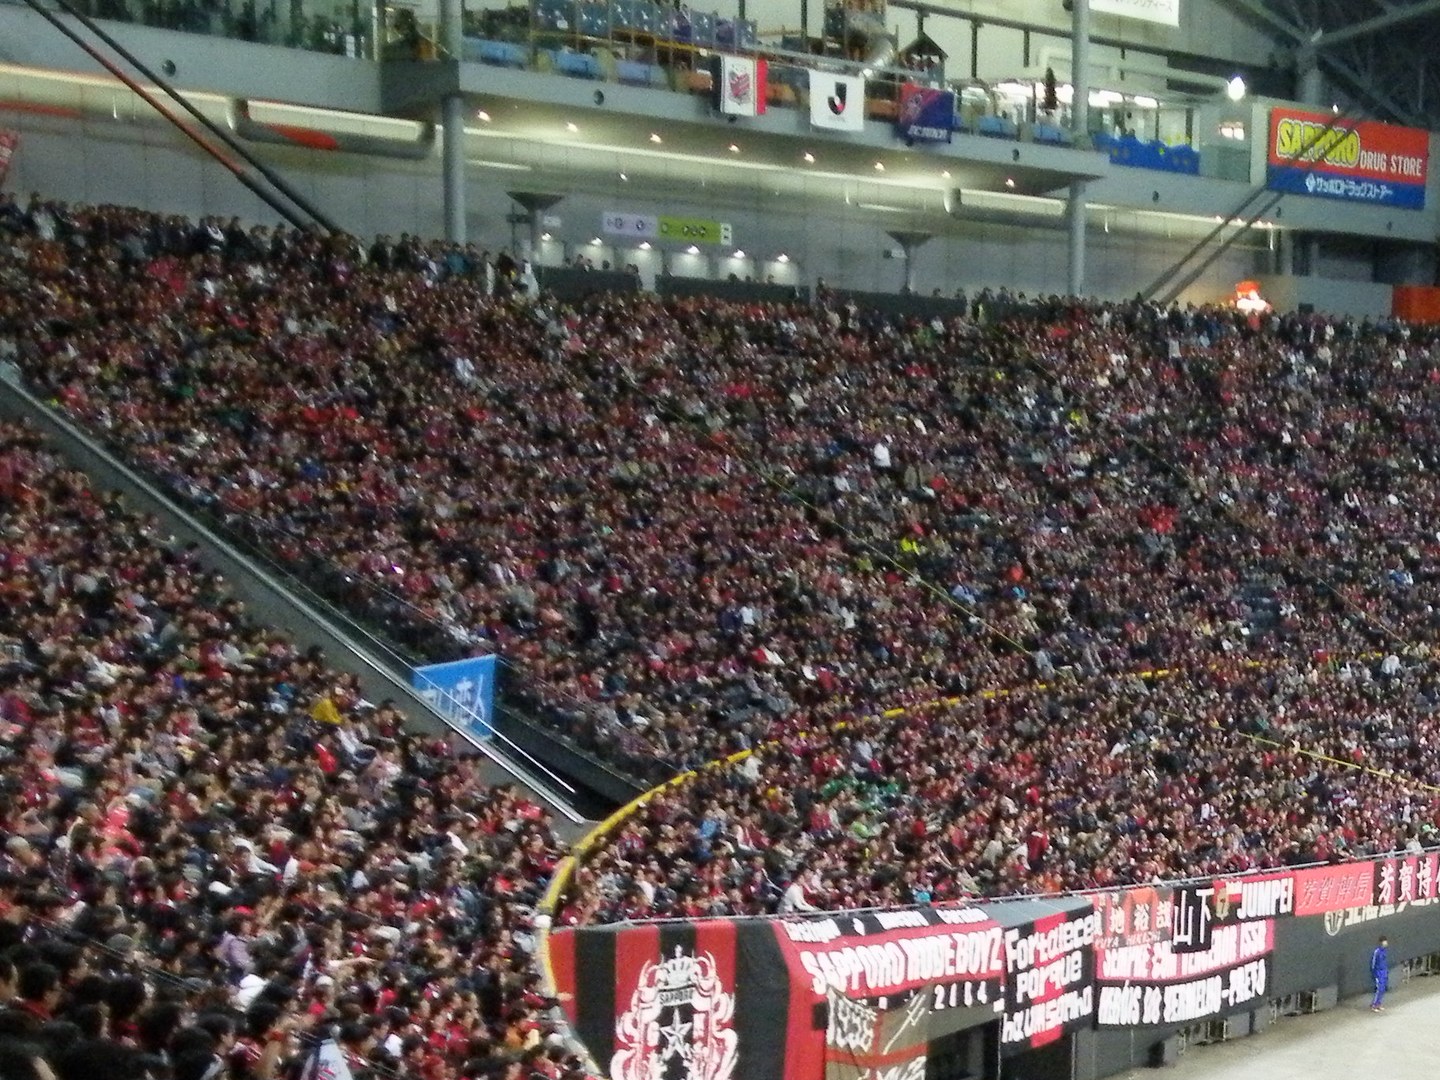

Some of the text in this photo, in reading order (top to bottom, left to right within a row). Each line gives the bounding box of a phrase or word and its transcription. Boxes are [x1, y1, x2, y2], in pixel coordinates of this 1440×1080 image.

[1359, 150, 1387, 173] DRUG
[1390, 155, 1423, 177] STORE
[1237, 877, 1295, 919] JUMPEI
[1298, 872, 1372, 909] 芳賀博信
[1172, 888, 1215, 946] 山下
[800, 941, 905, 996] SAPPORO
[953, 927, 1003, 975] BOYZ
